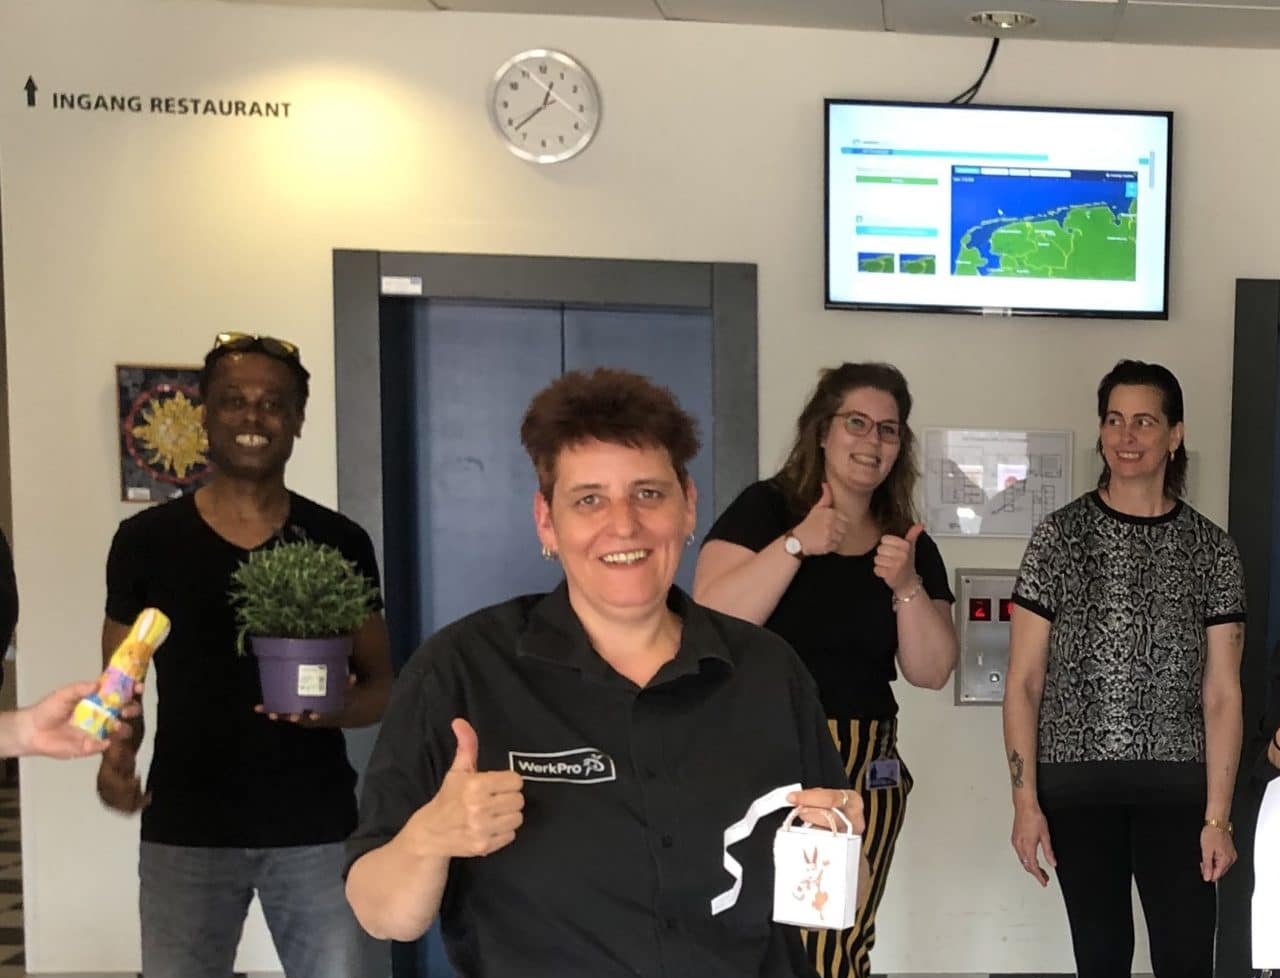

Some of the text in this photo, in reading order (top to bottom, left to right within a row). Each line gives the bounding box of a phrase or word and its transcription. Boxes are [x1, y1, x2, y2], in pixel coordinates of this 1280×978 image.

[52, 92, 292, 118] INGANG RESTAURANT
[518, 760, 582, 775] WerkPro
